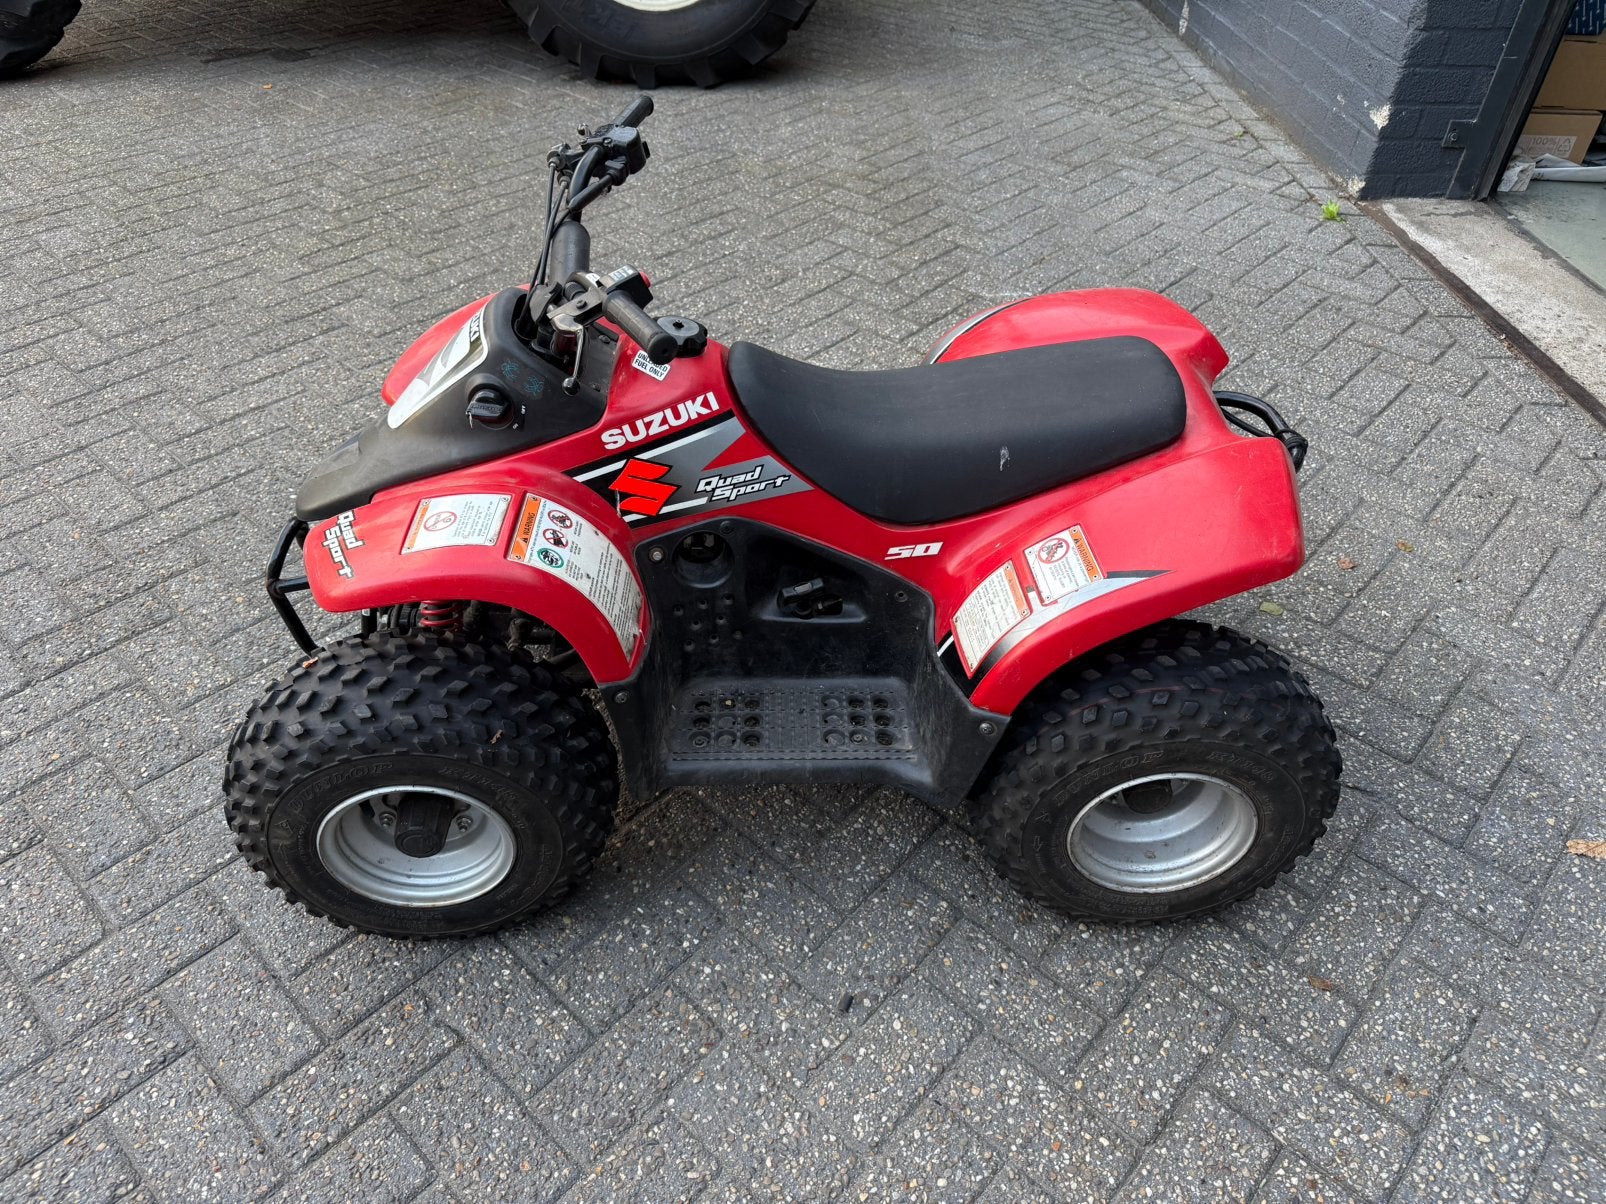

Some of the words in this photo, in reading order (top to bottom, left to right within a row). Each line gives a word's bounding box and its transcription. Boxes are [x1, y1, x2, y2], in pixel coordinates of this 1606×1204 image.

[634, 358, 648, 371] FUEL
[648, 366, 665, 378] ONLY
[601, 391, 720, 450] SUZUKI
[695, 464, 765, 494] Quad
[709, 474, 792, 503] Sport
[336, 511, 365, 550] Quad
[523, 512, 536, 536] WARNING
[322, 526, 355, 579] Sport
[885, 541, 943, 561] 50
[1077, 543, 1095, 573] WARNING
